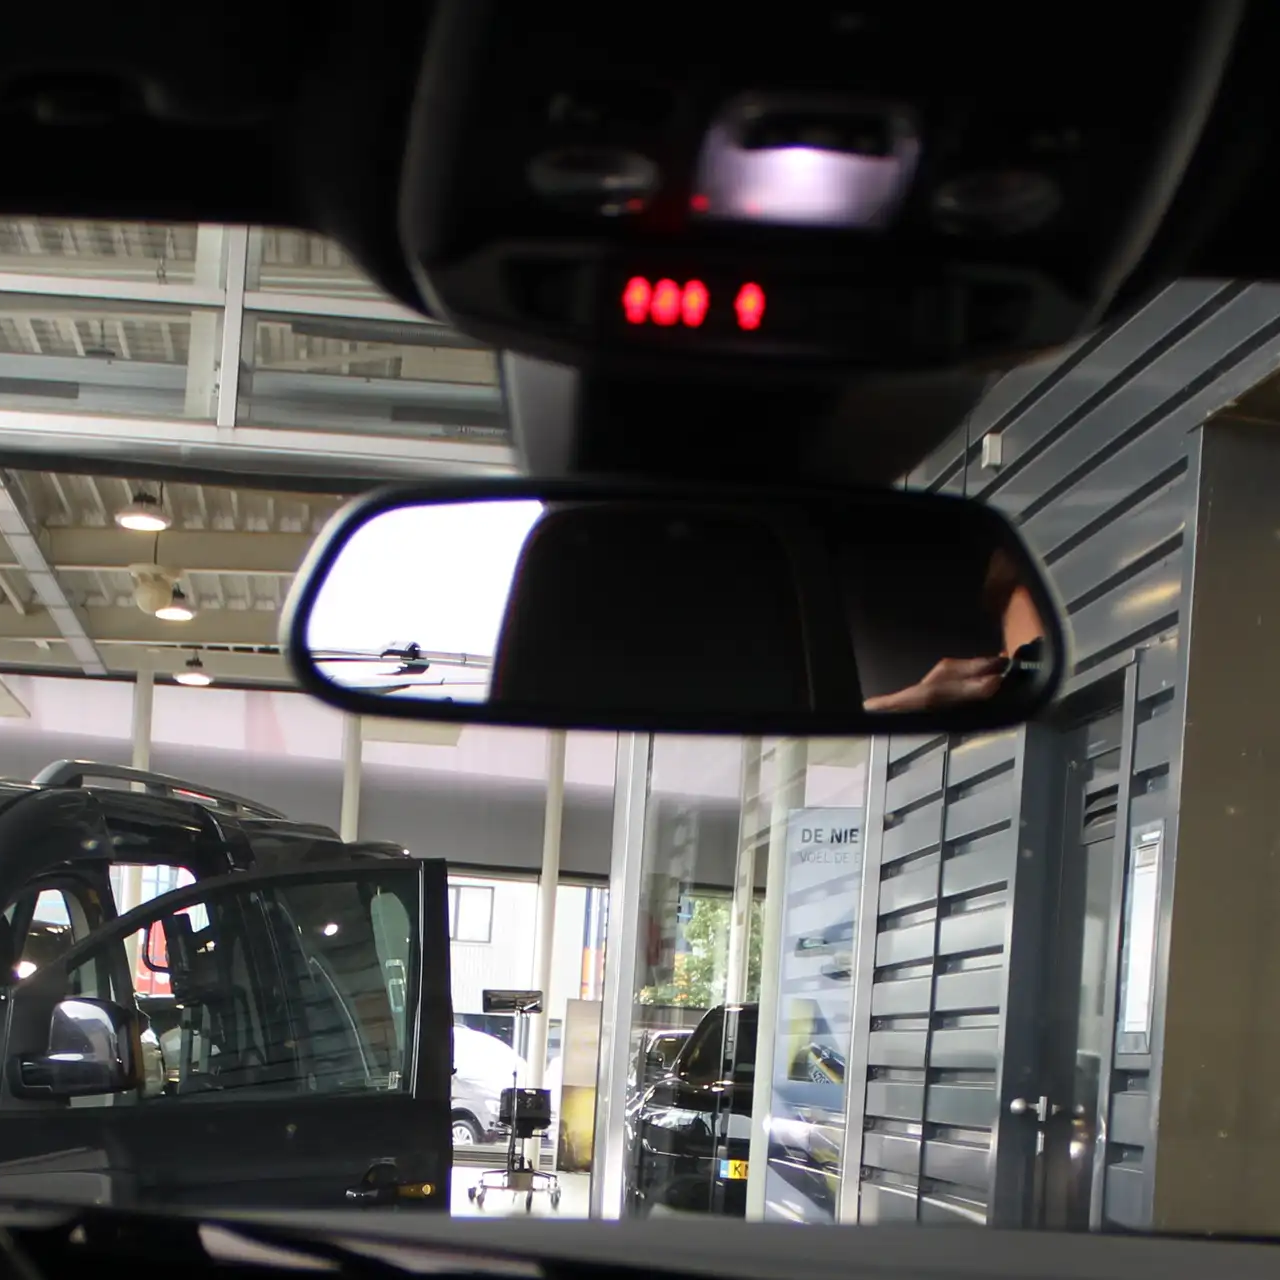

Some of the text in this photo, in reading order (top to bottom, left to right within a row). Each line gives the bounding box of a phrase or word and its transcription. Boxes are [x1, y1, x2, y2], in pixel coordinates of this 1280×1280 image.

[801, 828, 859, 844] DE NIE
[800, 850, 831, 863] VOEL
[834, 852, 852, 864] DE
